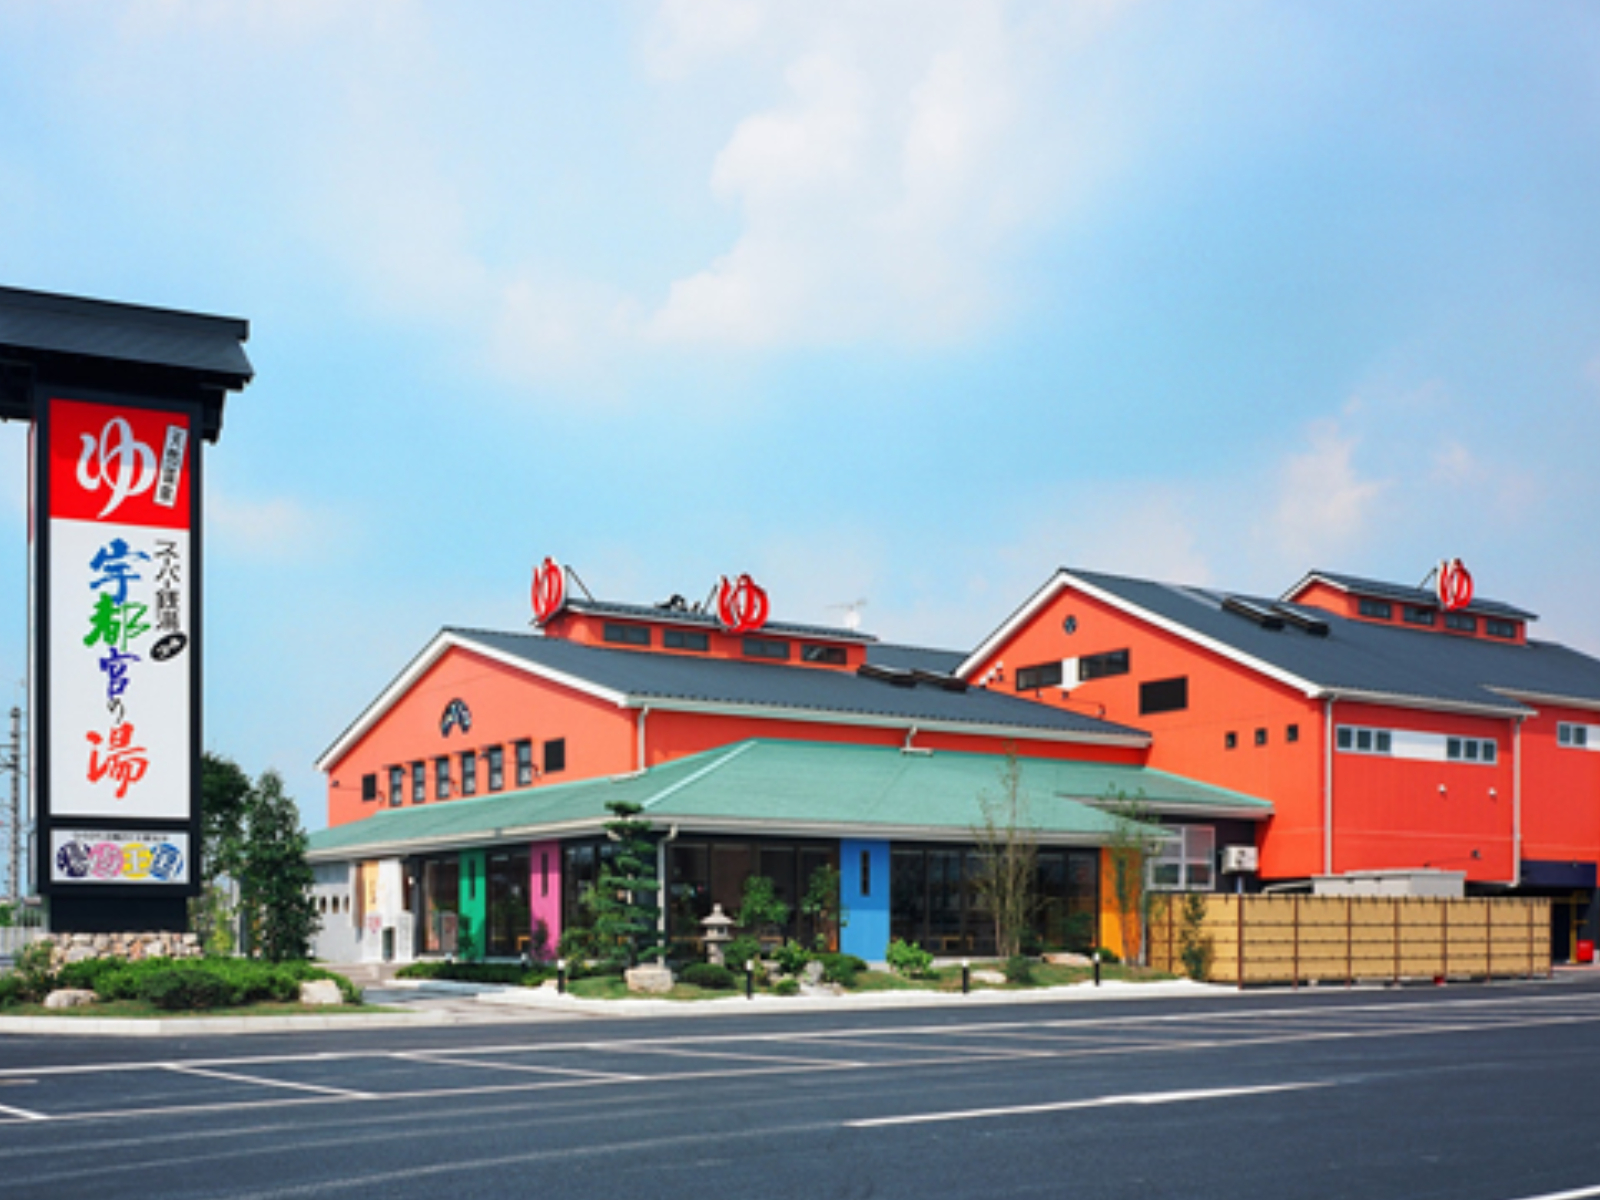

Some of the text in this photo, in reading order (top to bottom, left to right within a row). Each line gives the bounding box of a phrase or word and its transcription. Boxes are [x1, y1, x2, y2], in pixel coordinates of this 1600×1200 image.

[77, 416, 157, 518] ゆ
[531, 556, 565, 623] ゆ
[717, 574, 769, 632] ゆ
[1437, 558, 1475, 611] ゆ
[83, 538, 150, 798] 宇都宮の湯
